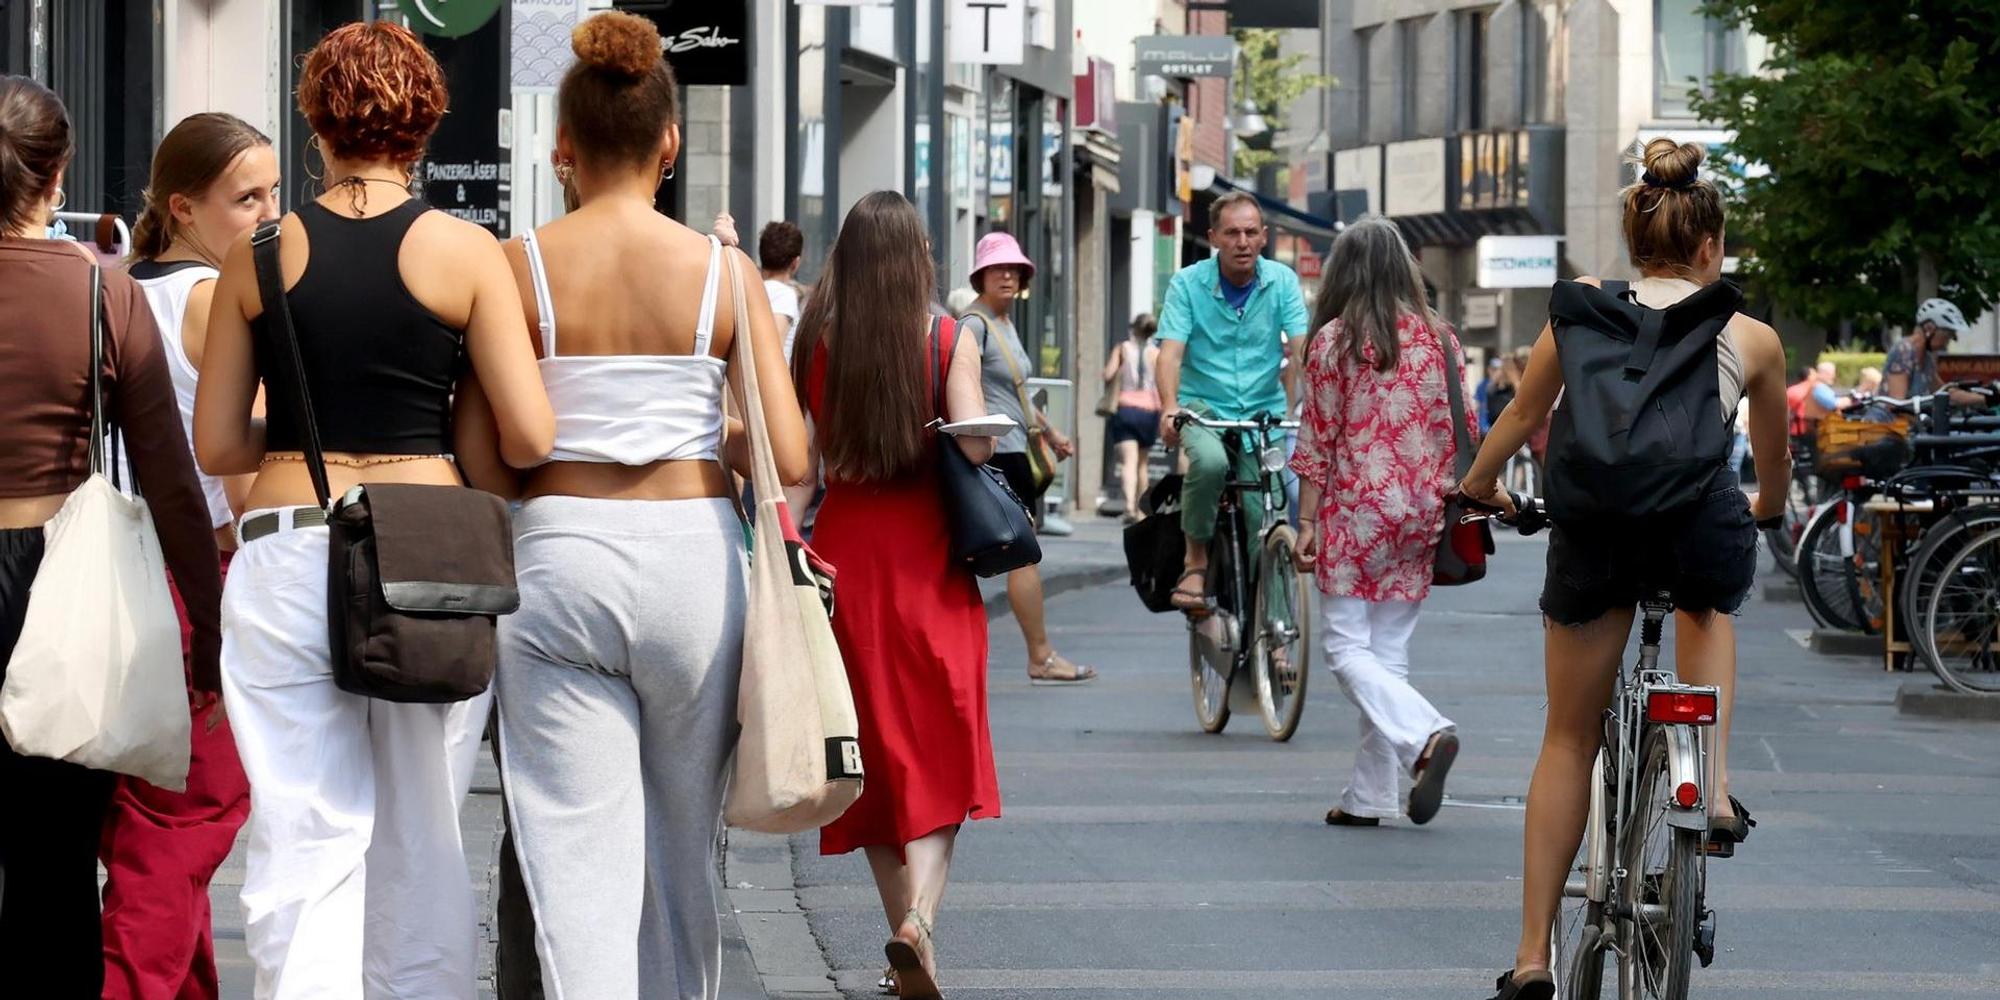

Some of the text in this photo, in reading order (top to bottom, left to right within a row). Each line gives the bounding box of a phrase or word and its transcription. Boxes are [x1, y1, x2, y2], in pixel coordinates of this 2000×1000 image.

[967, 3, 1006, 52] T
[669, 26, 739, 53] Sabo
[1161, 64, 1213, 74] OUTLET
[426, 160, 497, 180] PANZERGLÄSER
[456, 183, 465, 202] &
